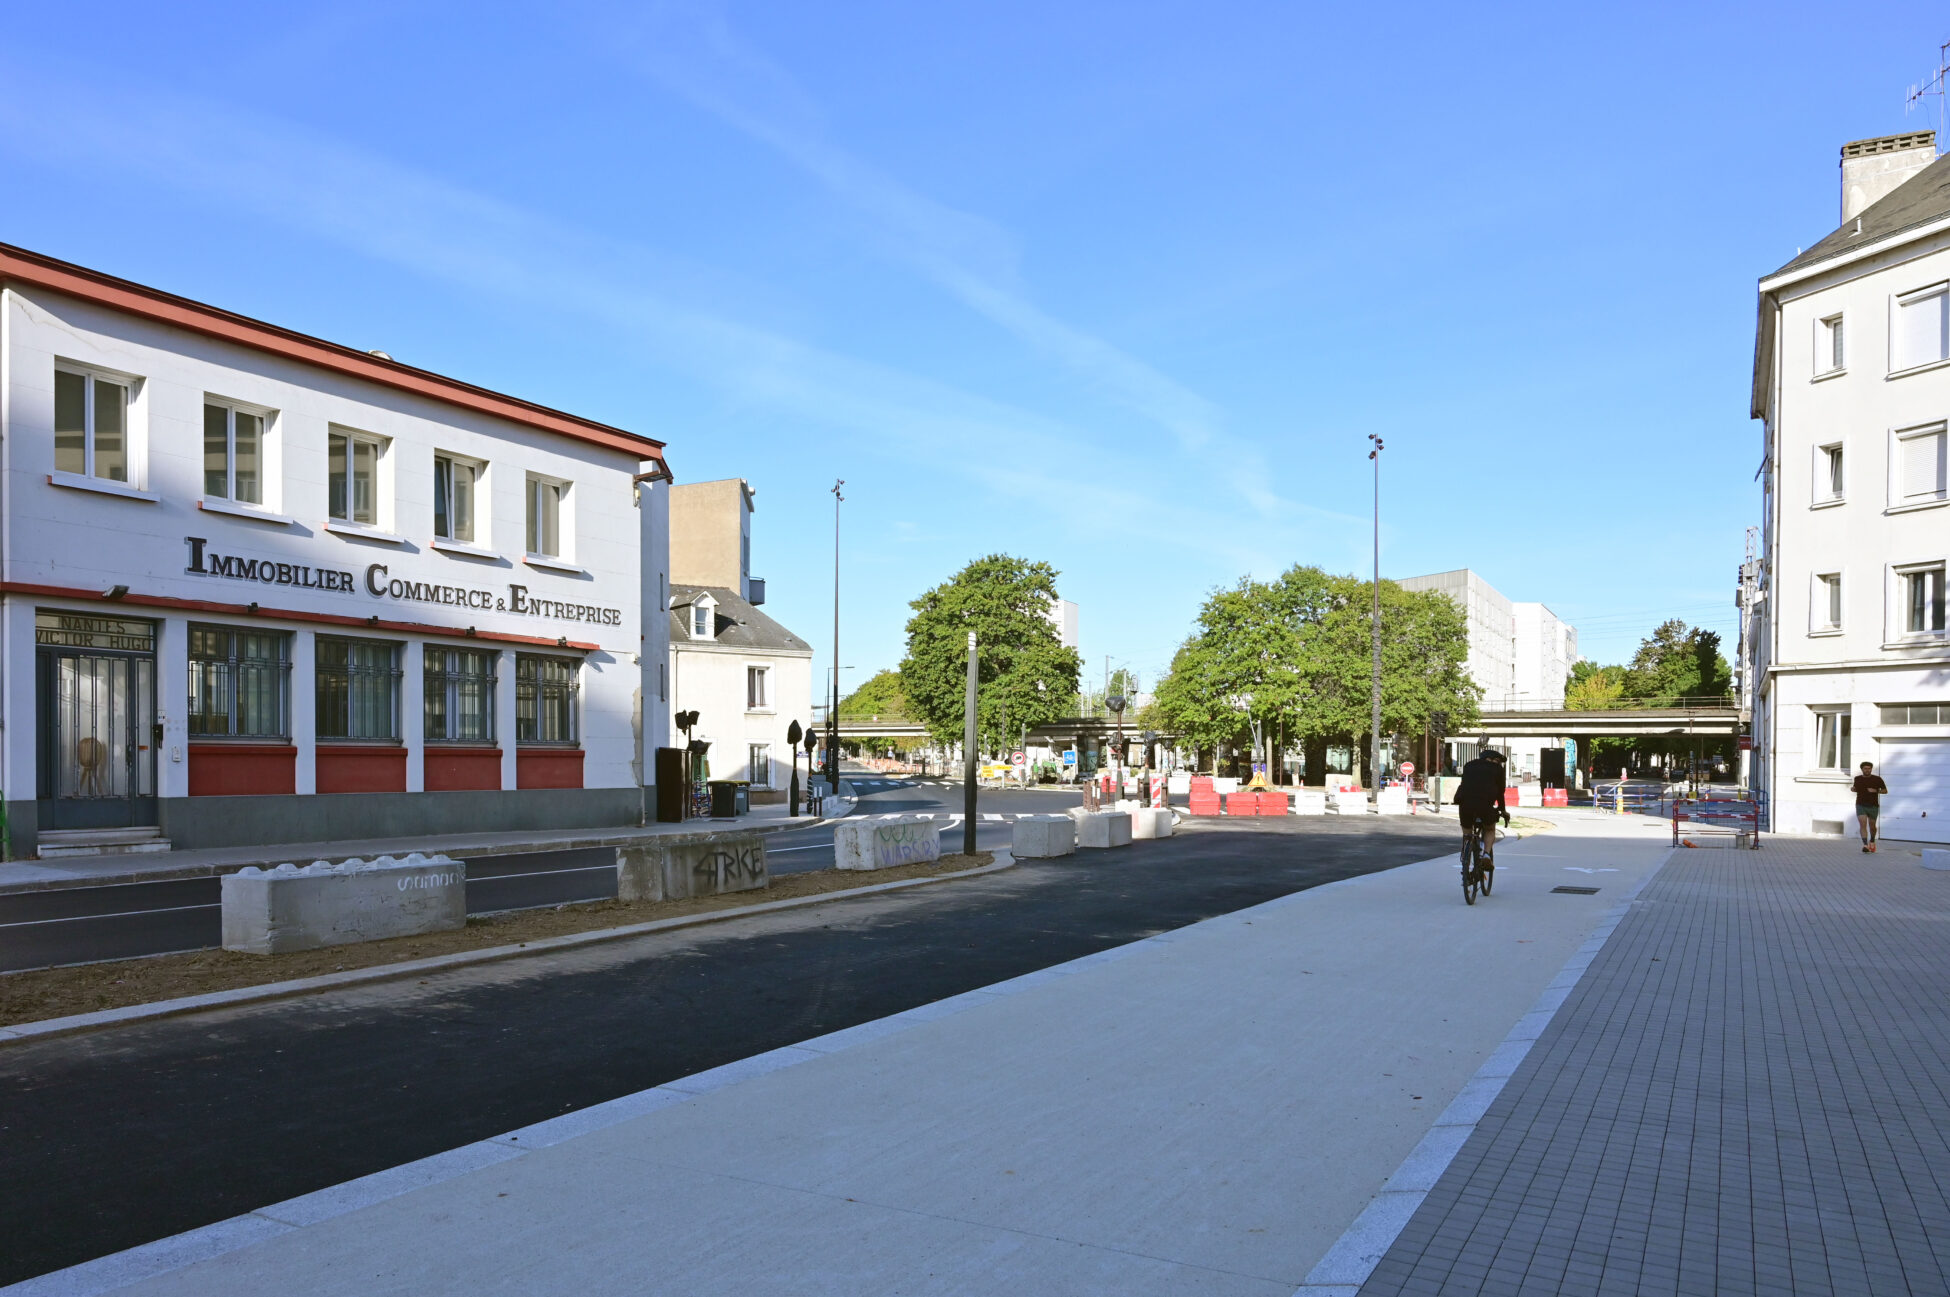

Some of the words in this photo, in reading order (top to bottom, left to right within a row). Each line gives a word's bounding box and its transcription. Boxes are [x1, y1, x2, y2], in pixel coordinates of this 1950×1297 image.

[496, 597, 506, 612] &
[61, 615, 126, 635] NANTES
[36, 628, 93, 648] VICTOR
[110, 634, 150, 651] HUGO
